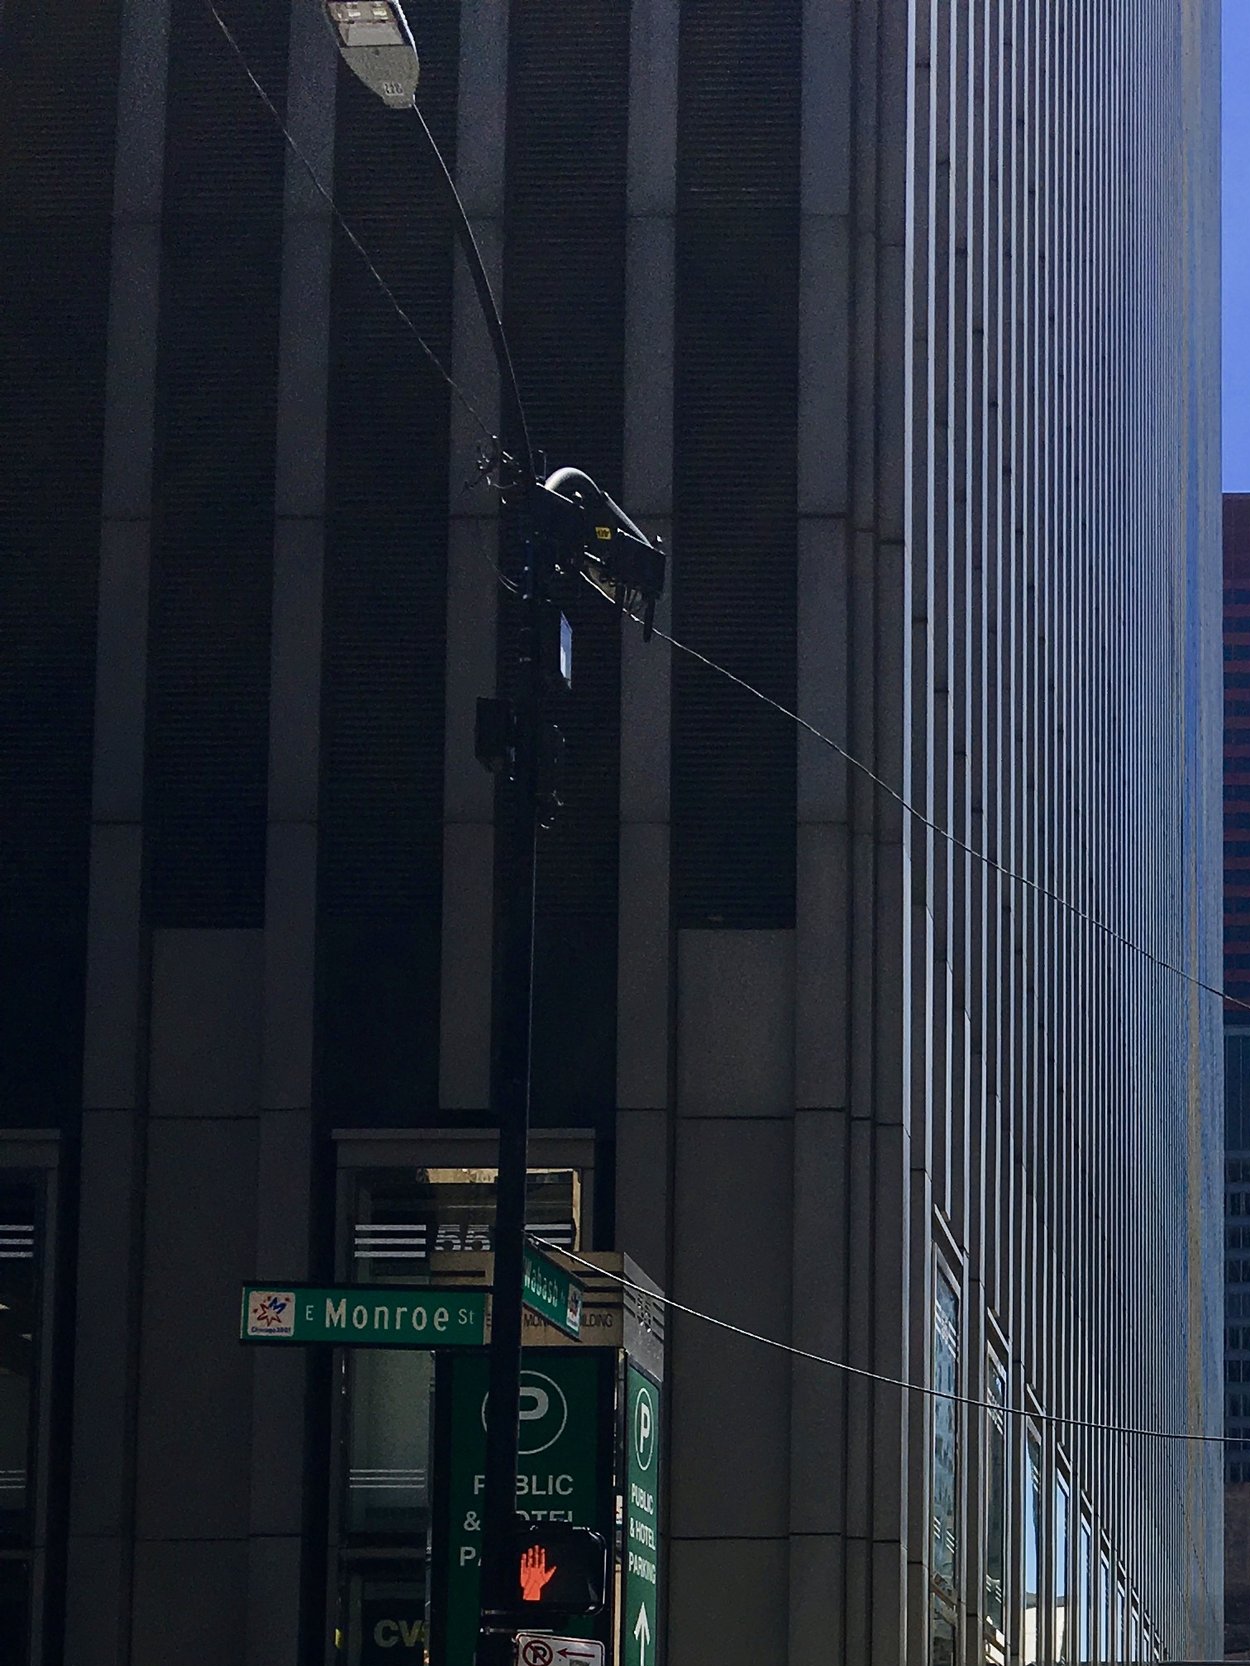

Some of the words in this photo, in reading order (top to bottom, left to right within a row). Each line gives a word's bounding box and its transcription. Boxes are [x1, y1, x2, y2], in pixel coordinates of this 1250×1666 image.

[522, 1256, 558, 1308] Wabash
[305, 1304, 315, 1321] E
[324, 1297, 451, 1331] Monroe
[457, 1306, 476, 1326] St
[631, 1482, 654, 1516] PUBLIC
[463, 1511, 482, 1532] &
[636, 1521, 656, 1551] HOTEL
[628, 1551, 657, 1585] PARKING
[373, 1619, 425, 1648] CV
